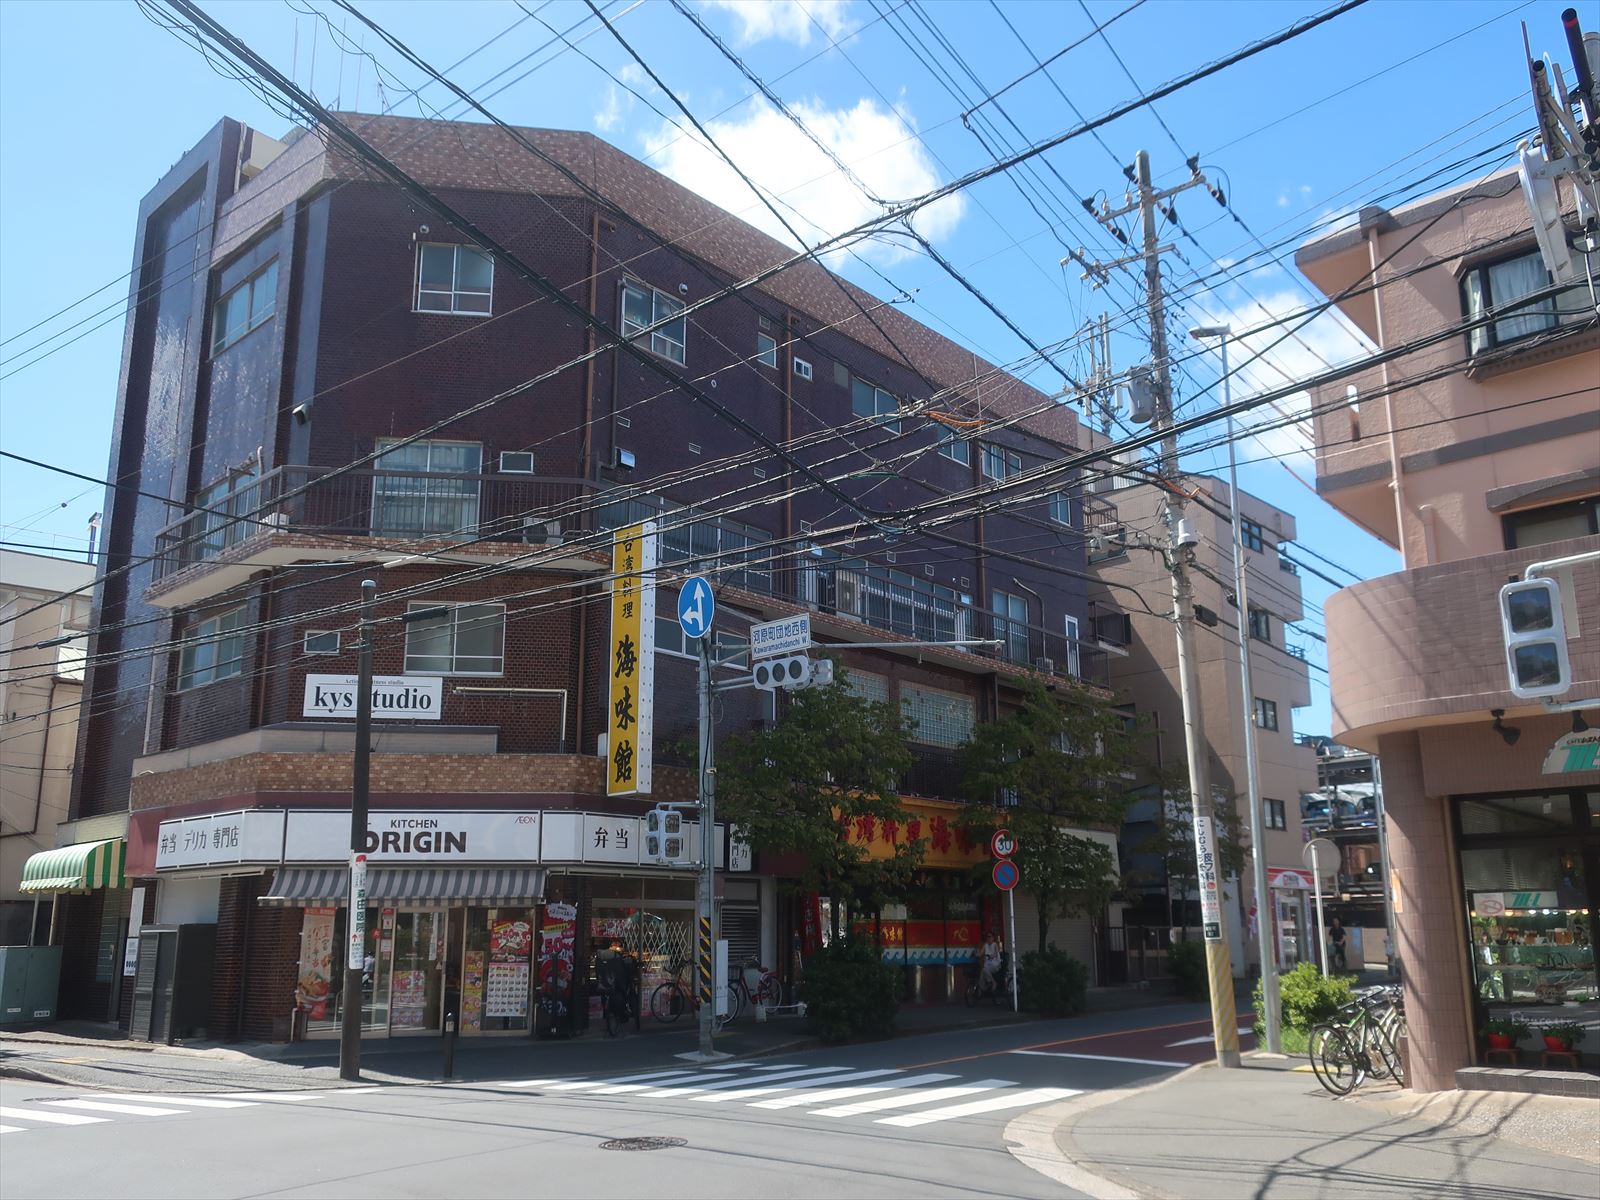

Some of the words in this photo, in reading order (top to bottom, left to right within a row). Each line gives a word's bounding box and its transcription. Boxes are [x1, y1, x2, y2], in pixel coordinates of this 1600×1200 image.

[753, 619, 808, 645] 河原町団地西側
[754, 639, 801, 654] Kawaramachidanchi
[314, 686, 353, 713] kys
[371, 688, 432, 710] tudio
[614, 634, 638, 783] 海味館
[390, 819, 438, 829] KITCHEN
[1197, 820, 1207, 853] にしむら
[161, 832, 177, 855] 弁当
[184, 829, 207, 851] デリカ
[213, 826, 239, 849] 専門店
[594, 826, 628, 849] 弁当
